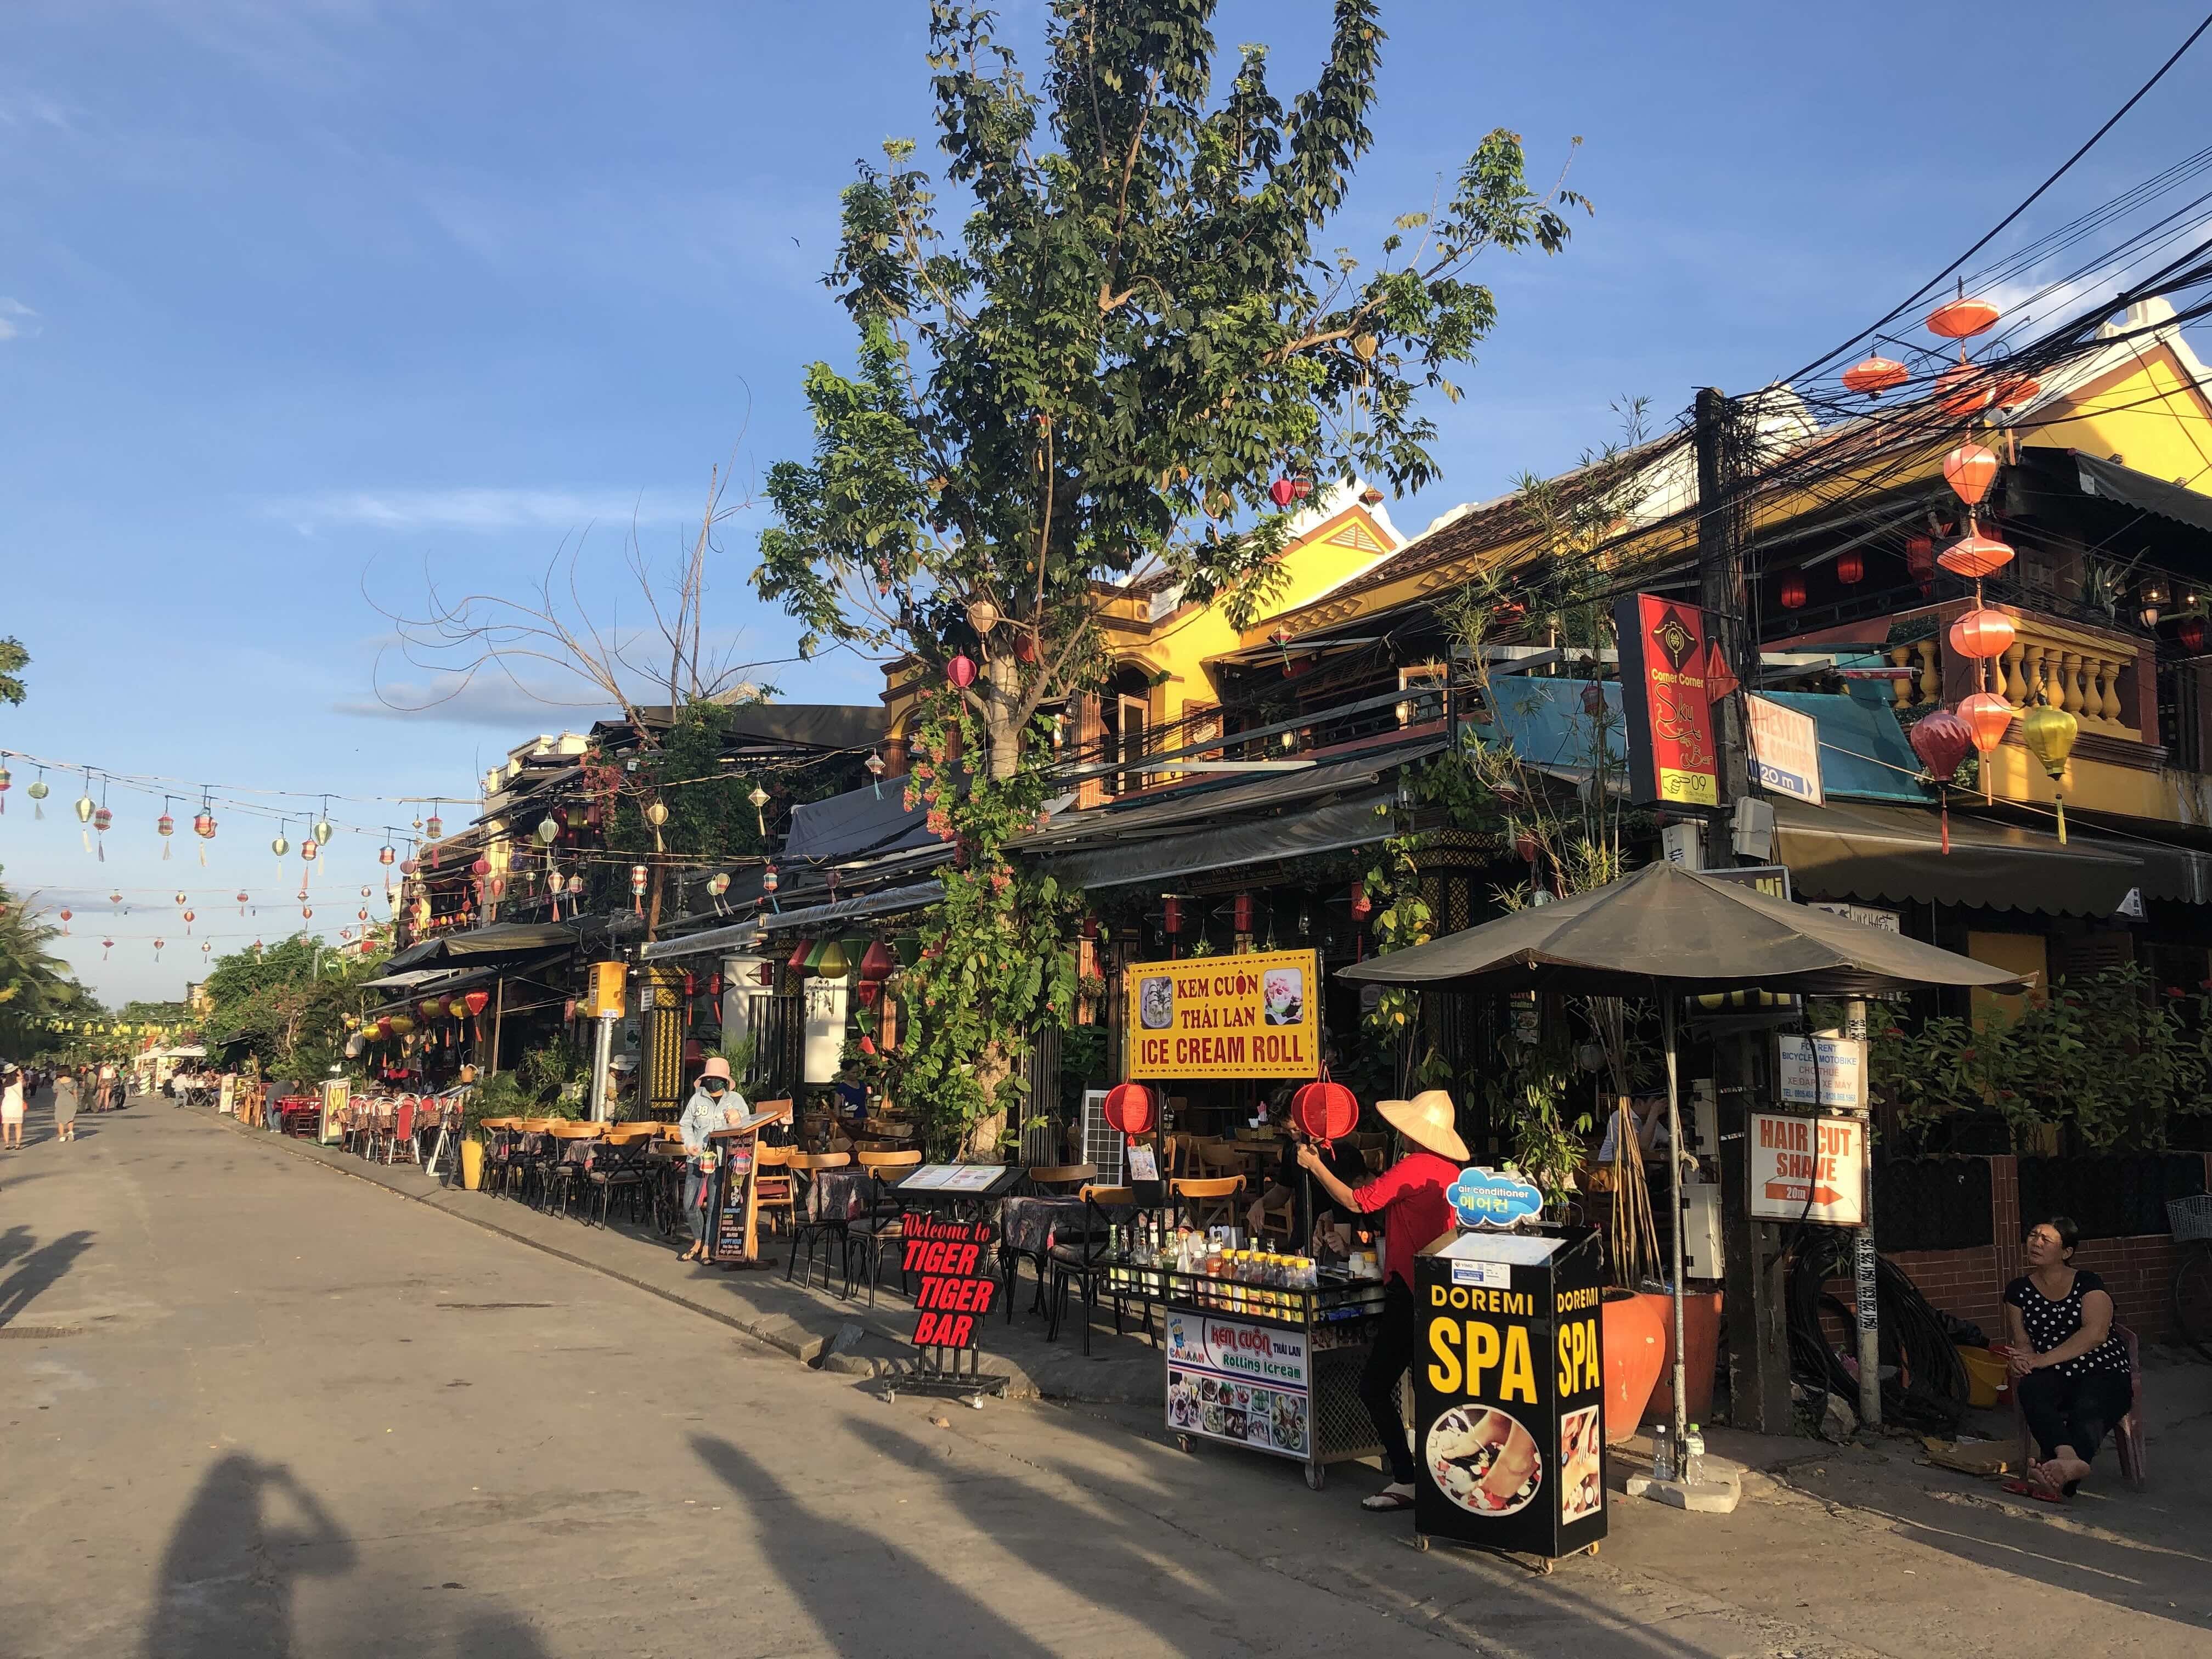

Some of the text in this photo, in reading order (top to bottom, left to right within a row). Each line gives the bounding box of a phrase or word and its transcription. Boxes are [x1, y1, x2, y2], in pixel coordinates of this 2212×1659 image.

[1651, 668, 1703, 688] Corner Corner
[1654, 682, 1702, 740] Sky
[1679, 741, 1714, 769] Bar
[1691, 775, 1706, 791] 09
[1177, 969, 1259, 1000] KEM CUỘN
[1181, 1003, 1256, 1029] THÁI LAN
[1141, 1035, 1304, 1064] ICE CREAM ROLL
[1782, 1052, 1857, 1065] BICYCLE MOTOBIKE
[1818, 1043, 1837, 1053] RENT
[1787, 1076, 1797, 1086] XE
[1822, 1079, 1832, 1088] XE
[328, 1088, 346, 1116] SPA
[695, 1104, 708, 1116] 38
[1760, 1119, 1808, 1152] HAIR
[1817, 1125, 1852, 1156] CUT
[1776, 1153, 1836, 1181] SHAVE
[1459, 1195, 1508, 1212] 에어컨
[1473, 1187, 1529, 1198] conditioner
[1786, 1186, 1806, 1200] 20m
[901, 1213, 991, 1242] Welcome to
[903, 1240, 979, 1276] TIGER
[917, 1276, 995, 1313] TIGER
[1431, 1284, 1533, 1317] DOREMI
[1557, 1286, 1599, 1313] DOREMI
[914, 1312, 973, 1347] BAR
[1273, 1342, 1287, 1355] THÁI
[1288, 1345, 1301, 1357] LAN
[1429, 1316, 1538, 1404] SPA
[1559, 1318, 1600, 1398] SPA
[1223, 1353, 1301, 1379] Rolling Icream
